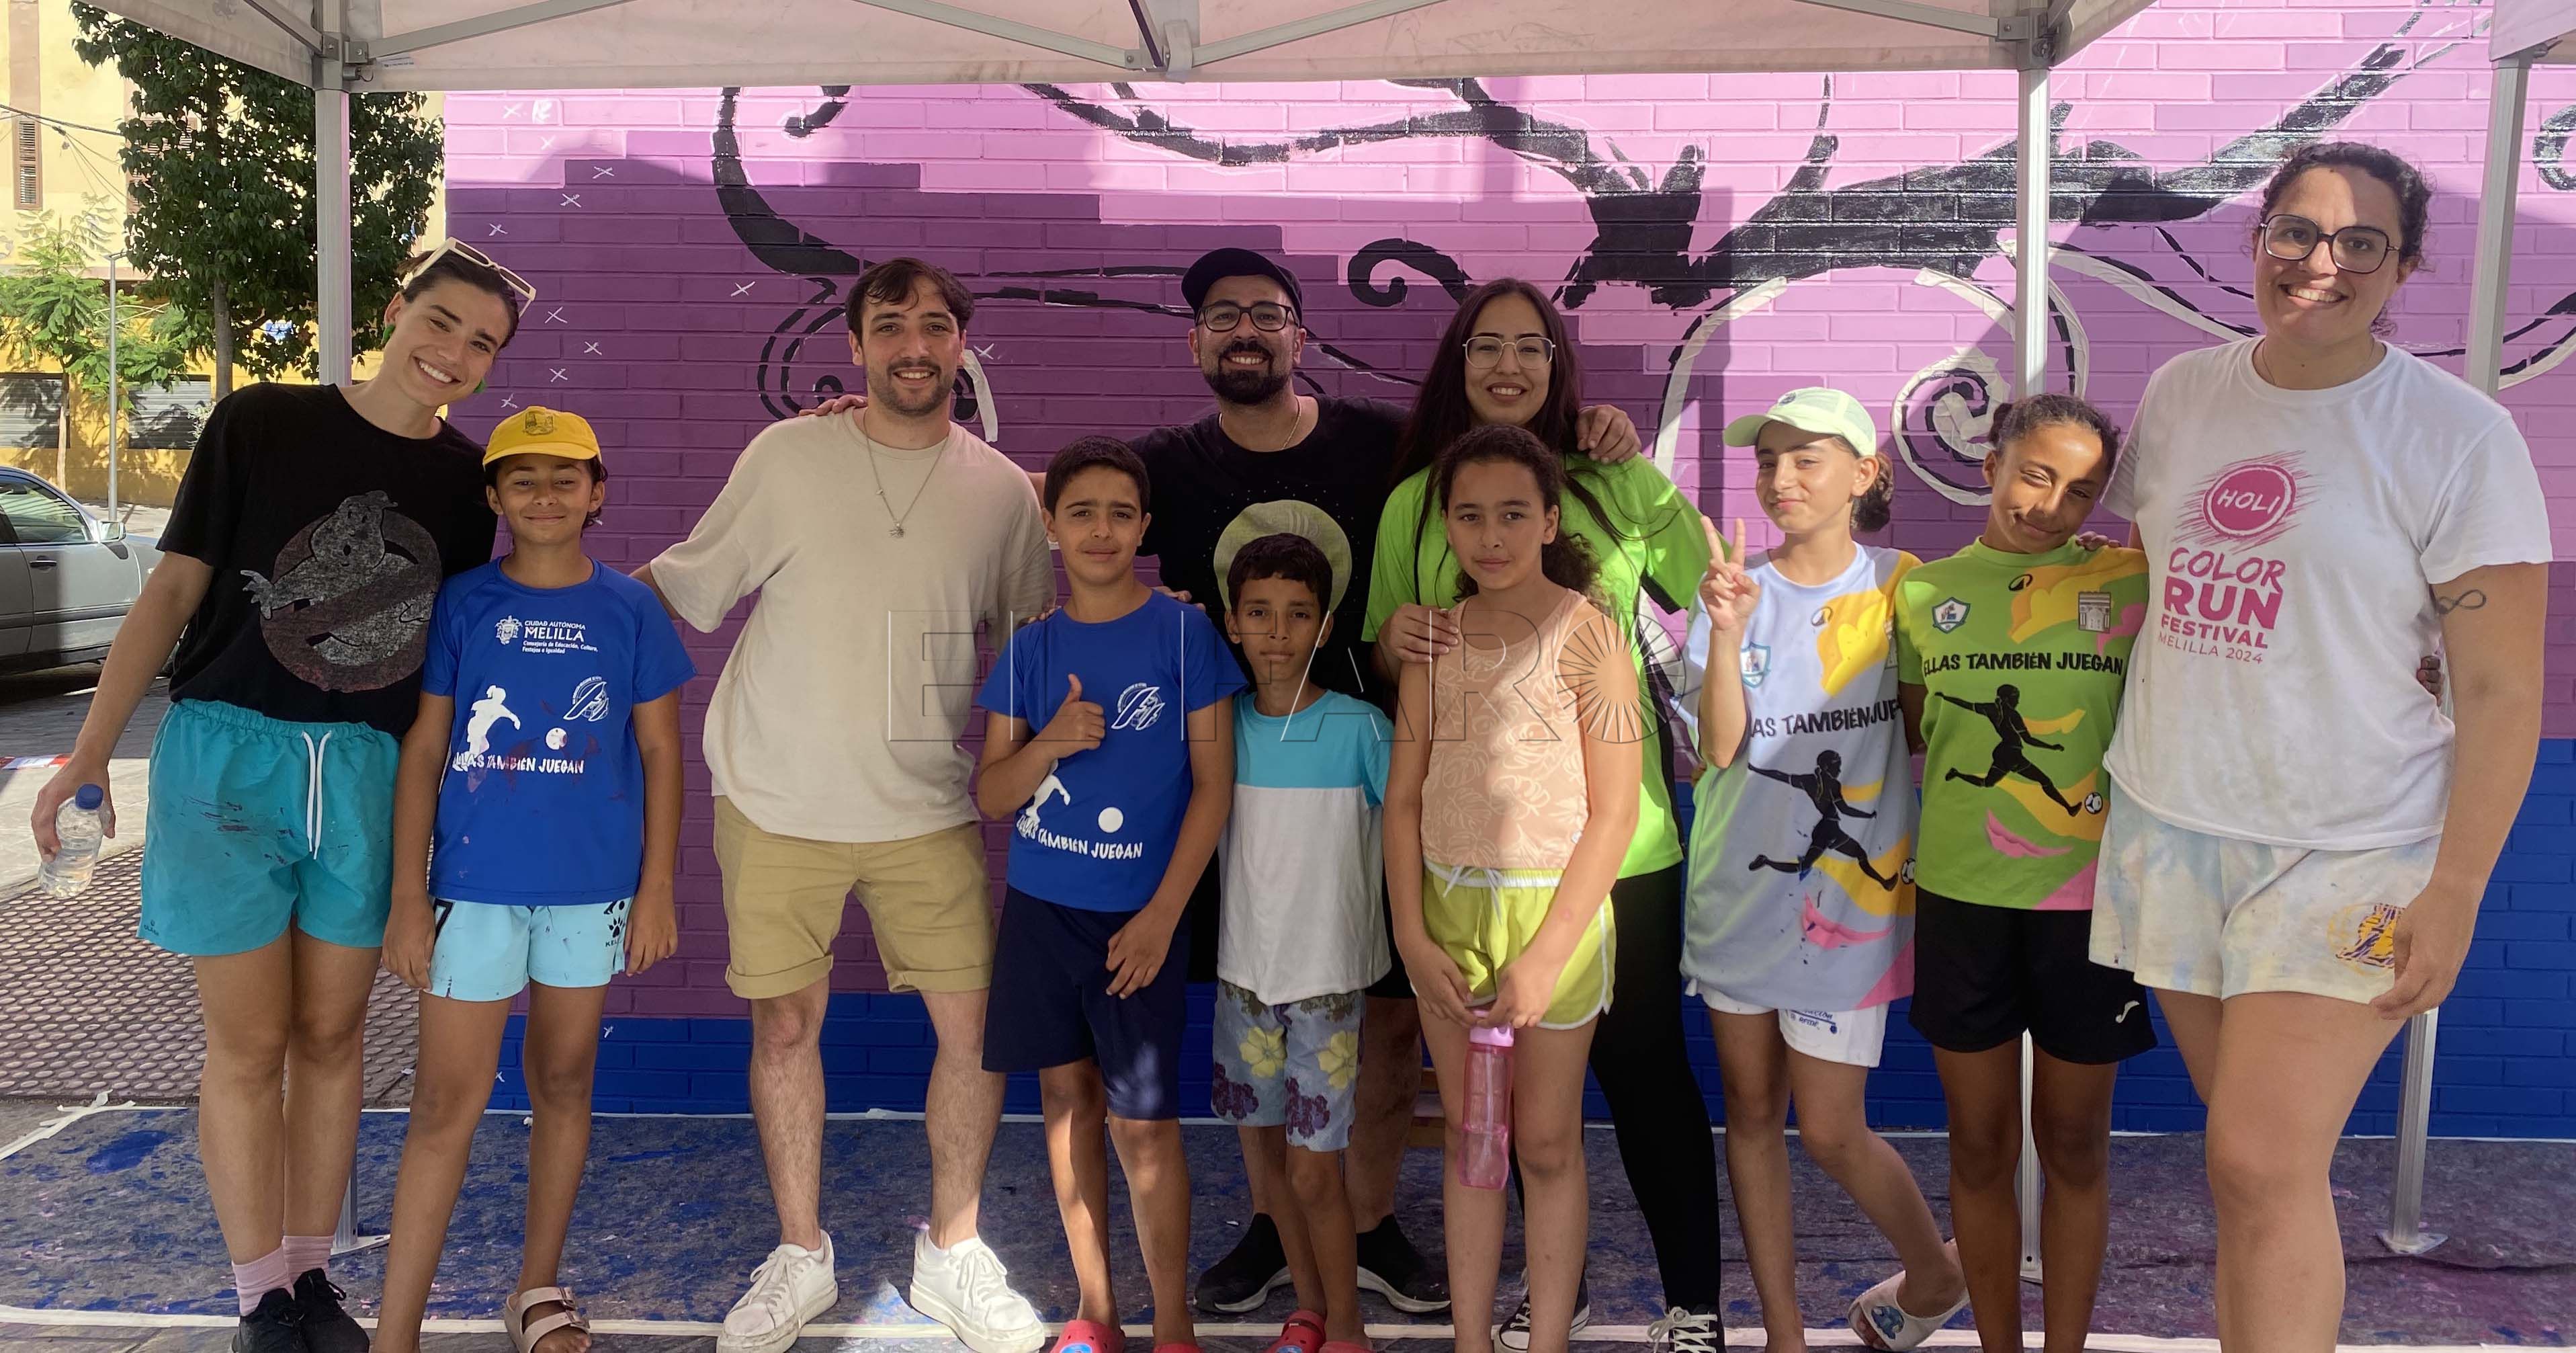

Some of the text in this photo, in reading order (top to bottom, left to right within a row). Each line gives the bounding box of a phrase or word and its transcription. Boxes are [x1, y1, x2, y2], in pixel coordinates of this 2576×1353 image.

[2217, 489, 2280, 514] HOLI
[2168, 547, 2286, 594] COLOR
[2164, 575, 2283, 630] RUN
[524, 626, 585, 642] MELILLA
[549, 621, 586, 630] AUTÓNOMA
[2161, 613, 2268, 649] FESTIVAL
[2157, 632, 2264, 665] MELILLA 2024
[1966, 651, 2051, 671] TAMBIÉN
[2056, 653, 2123, 675] JUEGAN
[1781, 706, 1871, 735] TAMBIÉN
[538, 757, 585, 774] JUEGAN
[1090, 841, 1143, 860] JUEGAN
